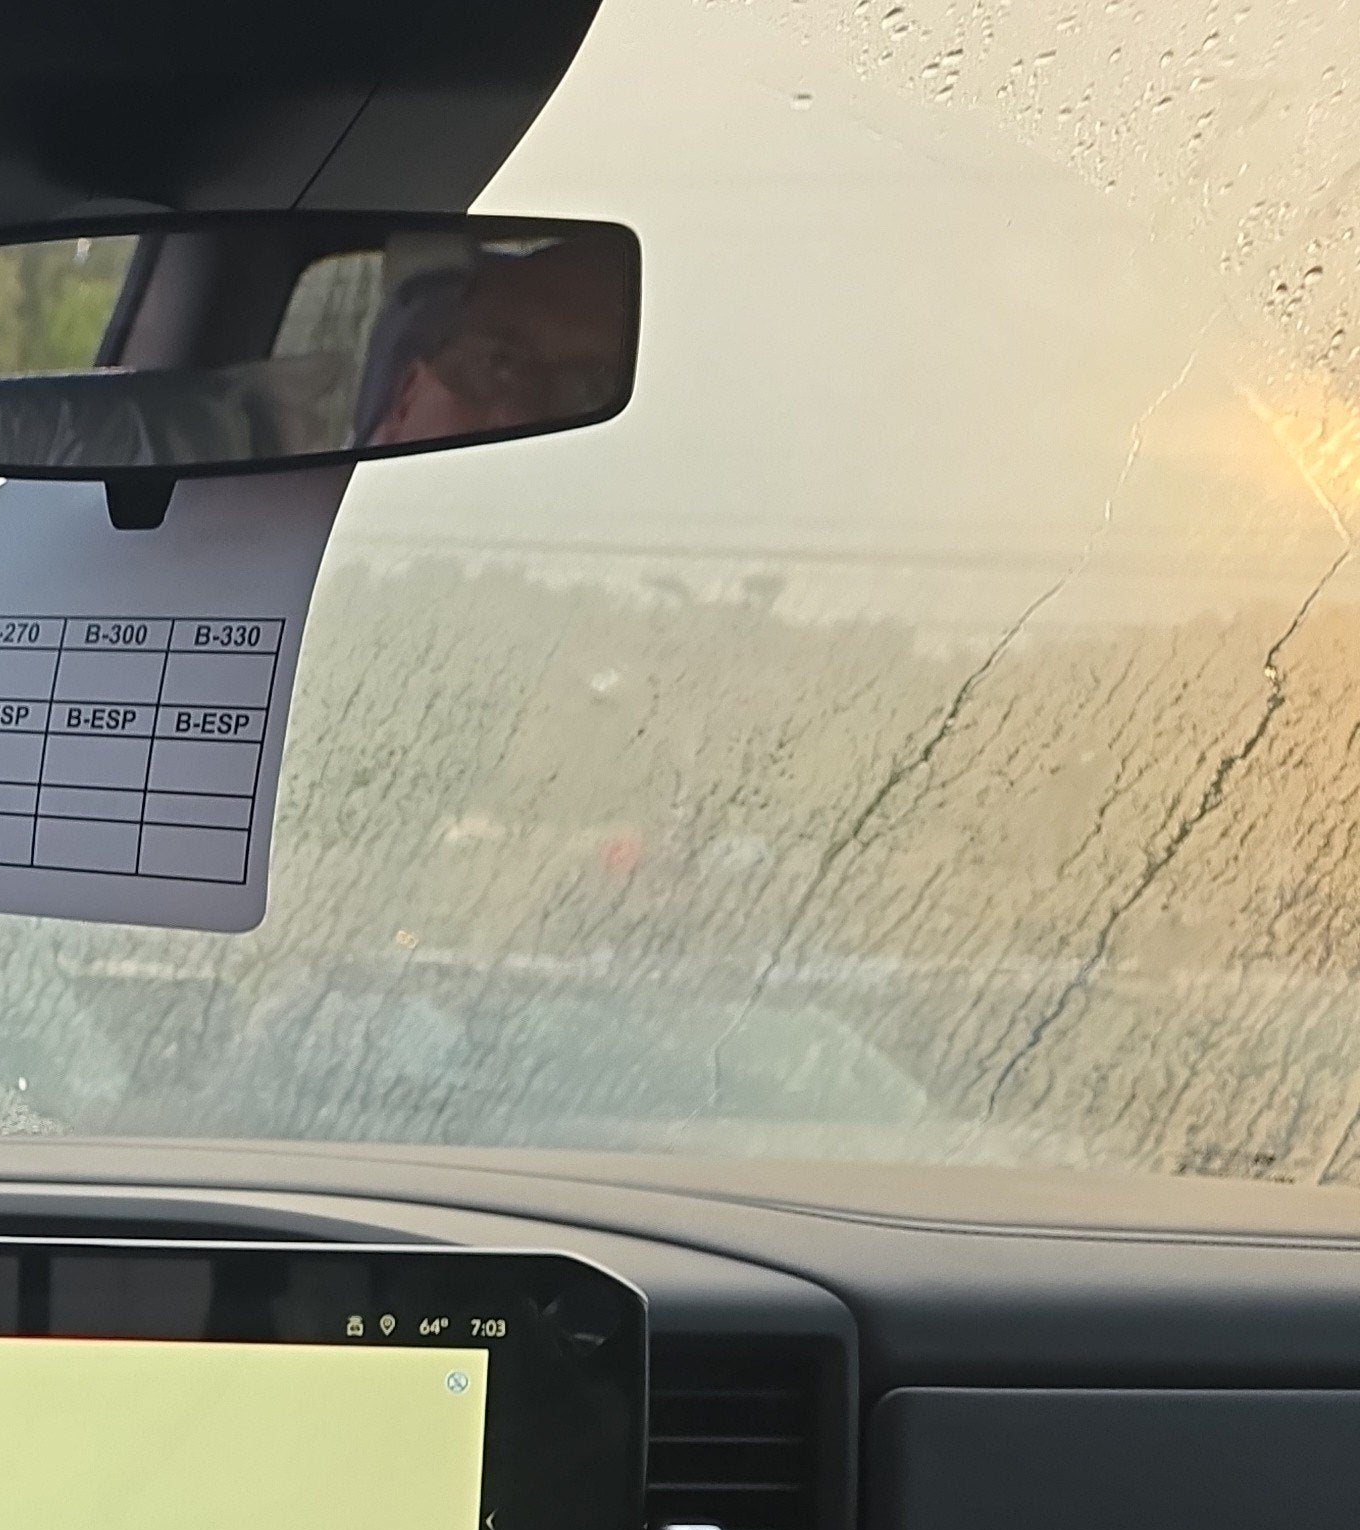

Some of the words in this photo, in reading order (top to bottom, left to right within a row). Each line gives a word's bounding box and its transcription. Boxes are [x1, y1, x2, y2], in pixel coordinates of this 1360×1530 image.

[85, 623, 148, 646] B-300
[194, 625, 261, 647] B-330
[66, 708, 137, 731] B-ESP
[175, 711, 250, 735] B-ESP
[471, 1318, 506, 1338] 7:03
